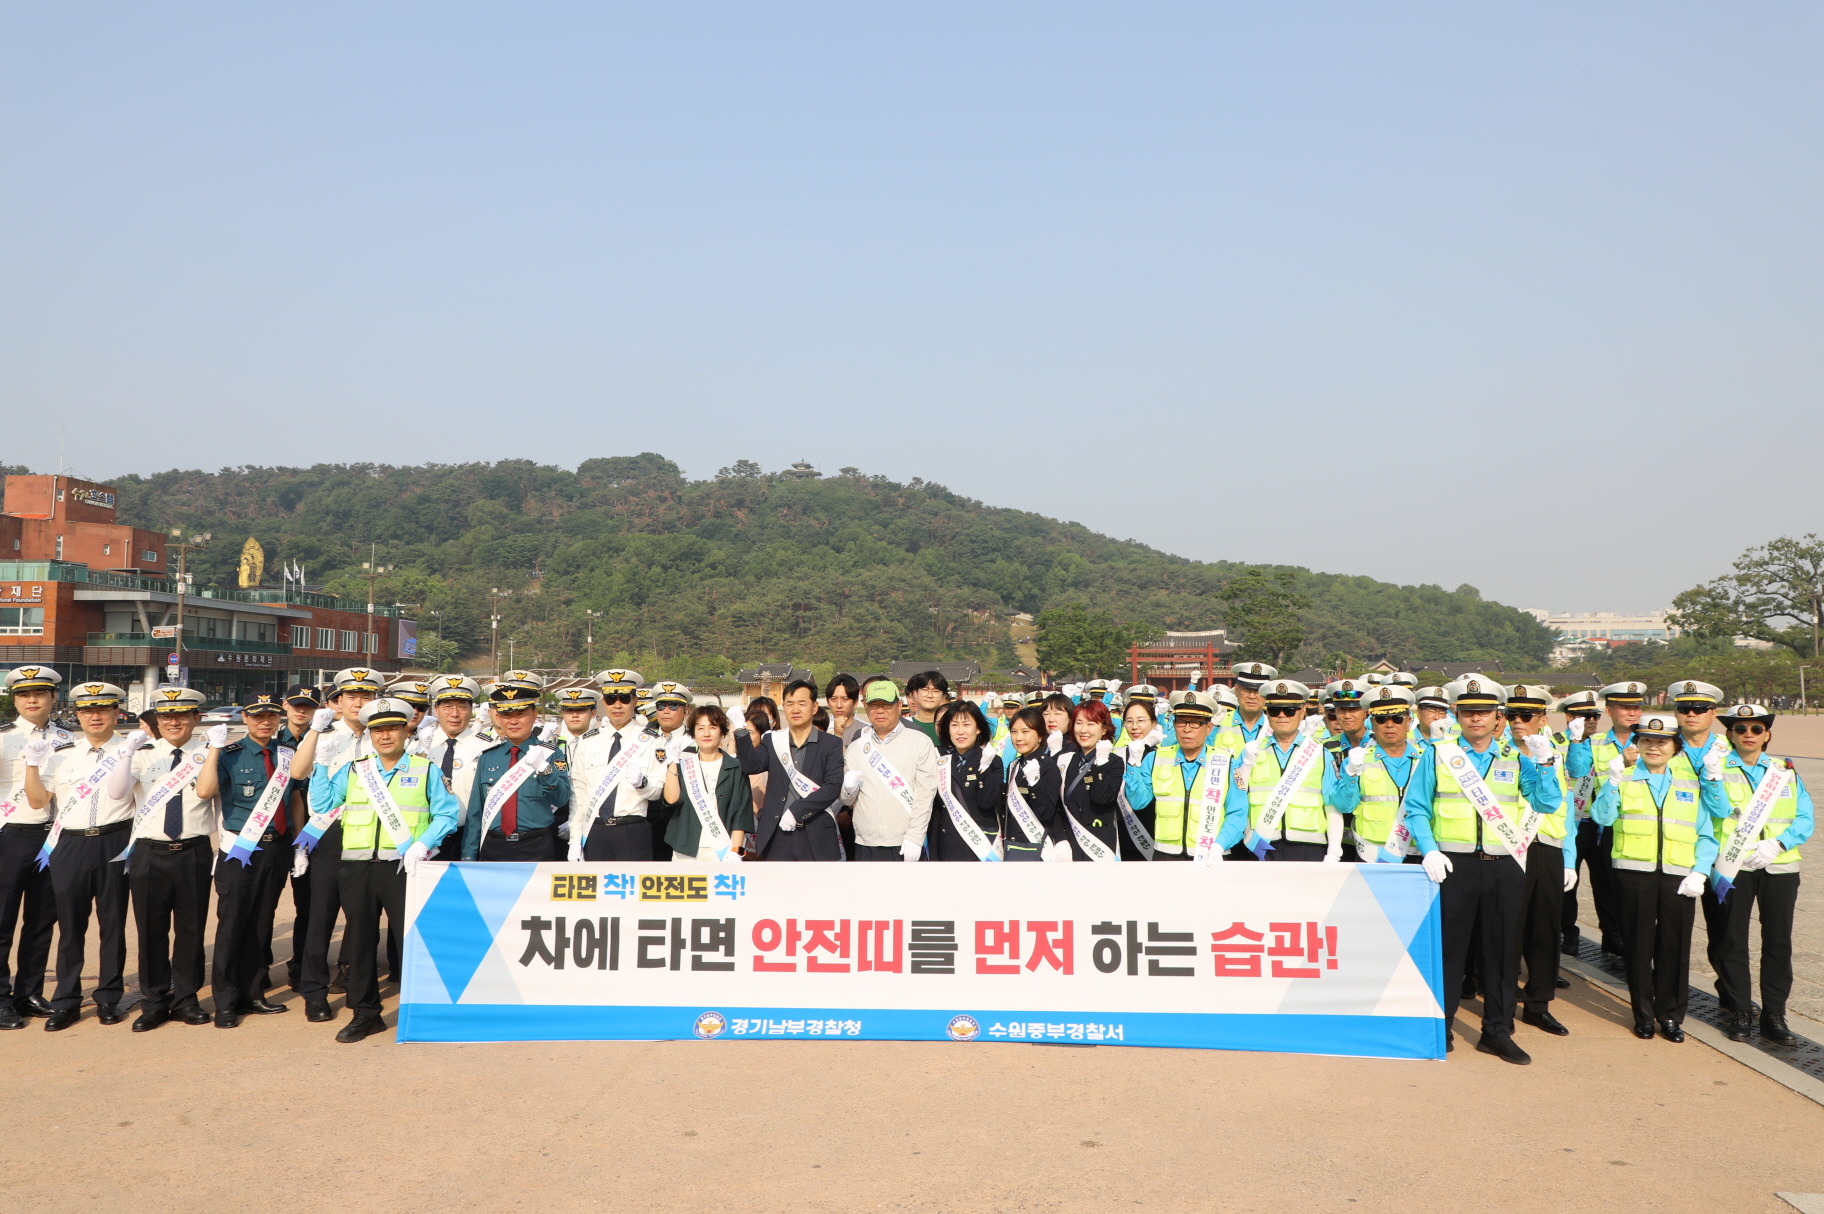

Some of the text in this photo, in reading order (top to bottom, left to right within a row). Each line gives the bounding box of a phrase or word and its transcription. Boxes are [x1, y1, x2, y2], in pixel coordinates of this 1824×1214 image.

[0, 585, 43, 597] 재단
[88, 768, 107, 785] 타면
[274, 772, 288, 788] 착
[877, 763, 914, 808] 타면 착 안전
[1210, 768, 1221, 786] 타면
[76, 782, 93, 799] 착
[262, 786, 280, 812] 안전도
[1205, 787, 1221, 804] 착
[252, 811, 269, 828] 착
[1204, 805, 1216, 834] 안전도
[1471, 786, 1489, 807] 타면
[1482, 805, 1504, 822] 착
[1497, 822, 1519, 847] 안전도
[1522, 811, 1539, 834] 전도
[1393, 823, 1410, 842] 착
[1198, 835, 1214, 850] 착
[553, 873, 746, 900] 타면 착! 안전도 착!
[518, 915, 1338, 979] 차에 타면 안전띠를 먼저 하는 습관!
[731, 1017, 862, 1036] 경기남부경찰청
[988, 1022, 1124, 1042] 수원중부경찰서
